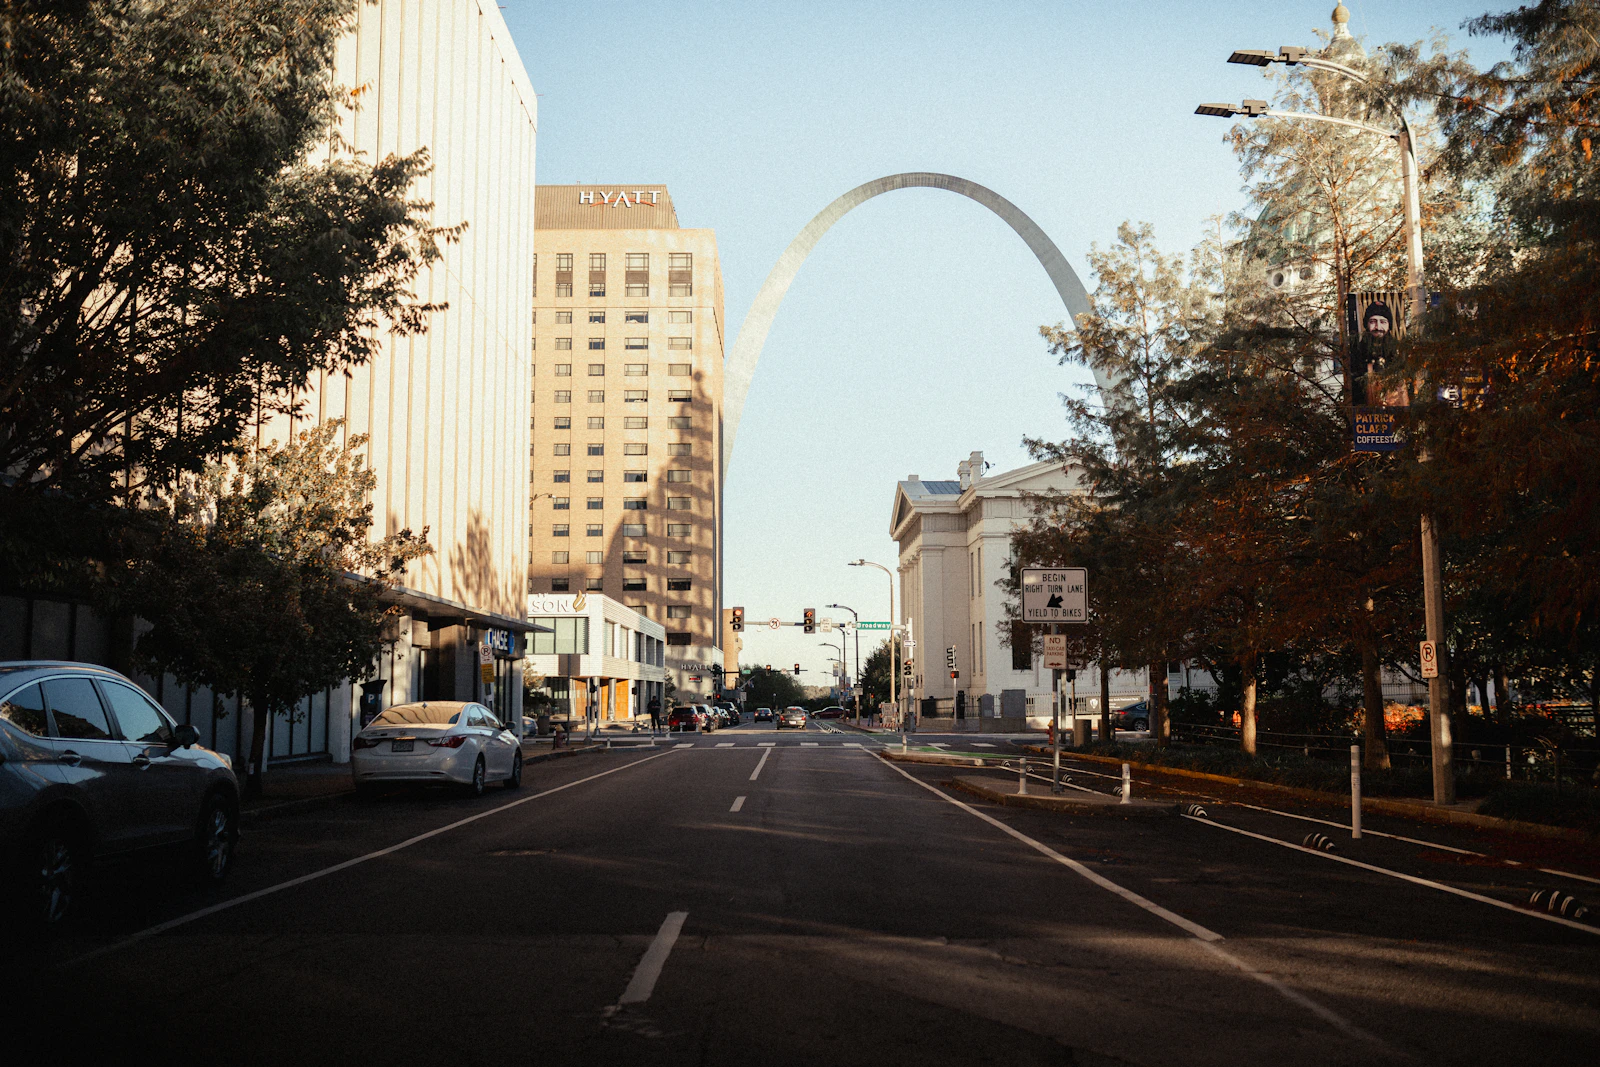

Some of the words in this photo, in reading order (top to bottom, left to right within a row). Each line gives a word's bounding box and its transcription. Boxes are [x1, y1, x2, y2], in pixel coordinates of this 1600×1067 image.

[579, 190, 661, 208] HYATT
[1356, 414, 1396, 423] PATRICK
[1042, 573, 1066, 582] BEGIN
[1025, 585, 1043, 593] RIGHT
[1047, 585, 1063, 593] TURN
[1067, 585, 1083, 593] LANE
[1028, 608, 1048, 617] YIELD
[1051, 608, 1059, 617] TO
[1062, 608, 1082, 617] BIKES
[488, 628, 508, 650] CHASE
